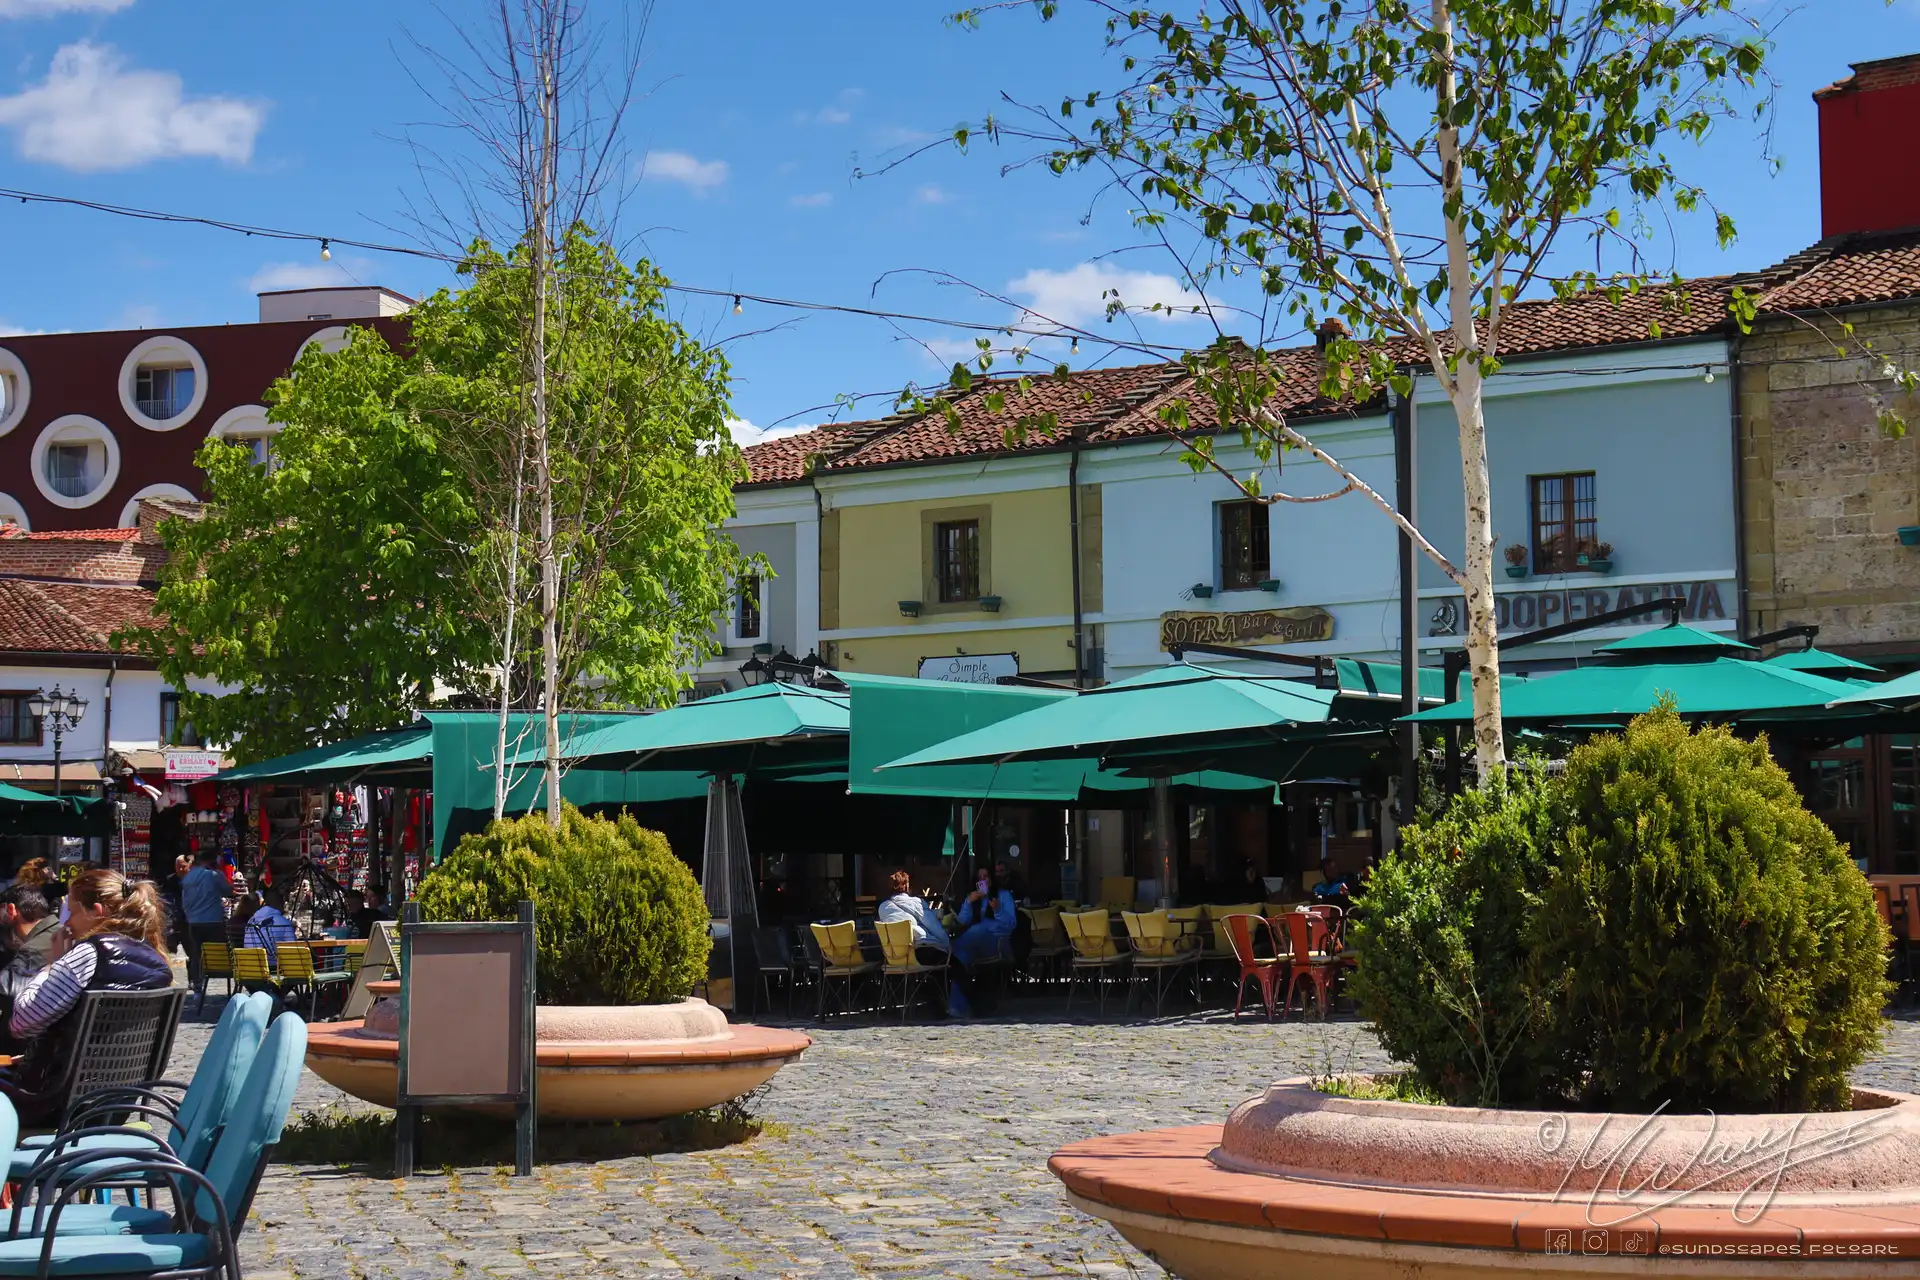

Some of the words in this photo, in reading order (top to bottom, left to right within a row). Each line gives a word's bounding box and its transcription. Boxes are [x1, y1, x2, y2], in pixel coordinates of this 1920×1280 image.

[1464, 582, 1726, 631] OOPERATIVA
[1163, 616, 1237, 646] SOFRA
[1241, 613, 1271, 630] Bar
[1272, 620, 1283, 634] &
[1284, 620, 1324, 640] Grill
[949, 658, 988, 677] Simple
